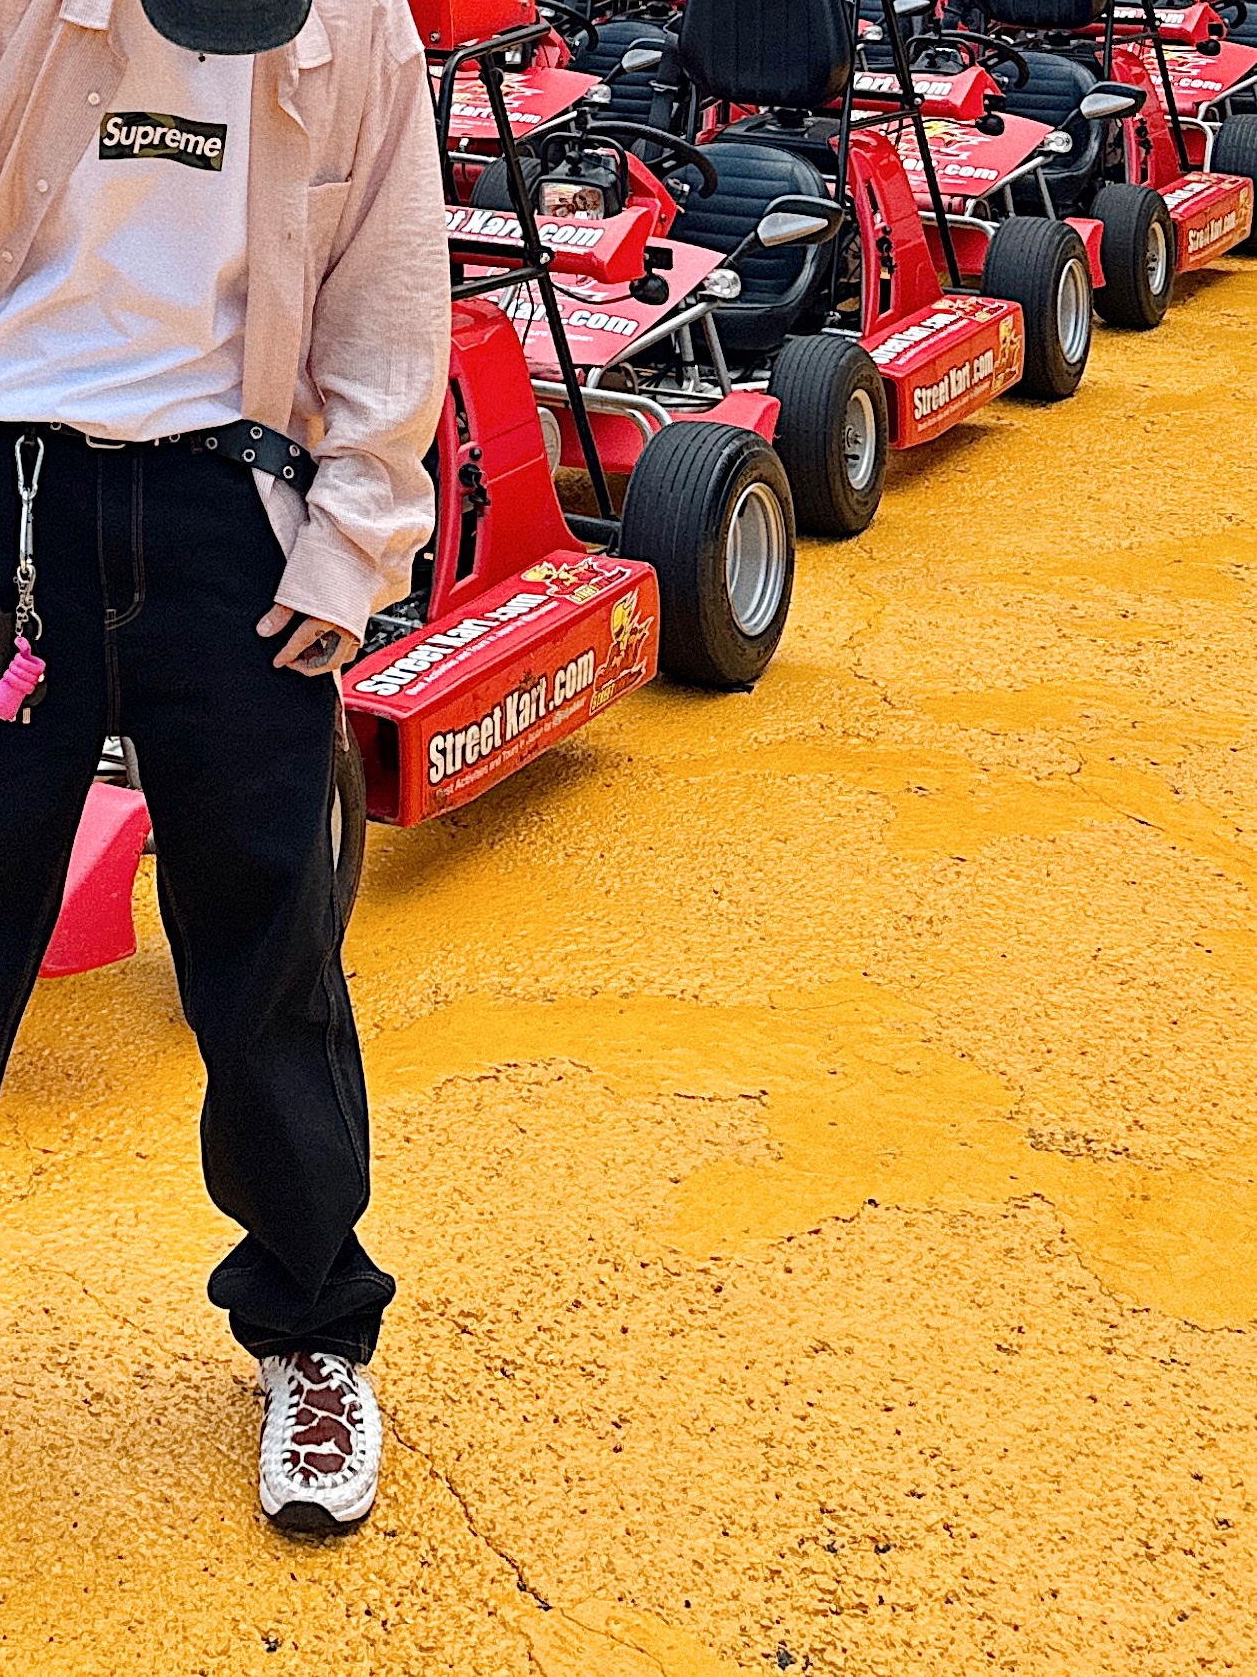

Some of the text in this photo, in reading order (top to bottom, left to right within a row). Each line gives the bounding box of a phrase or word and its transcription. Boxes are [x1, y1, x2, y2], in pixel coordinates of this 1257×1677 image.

[103, 117, 222, 158] Supreme
[355, 643, 455, 697] Street
[428, 705, 503, 784] Street
[505, 649, 595, 742] Kart.com
